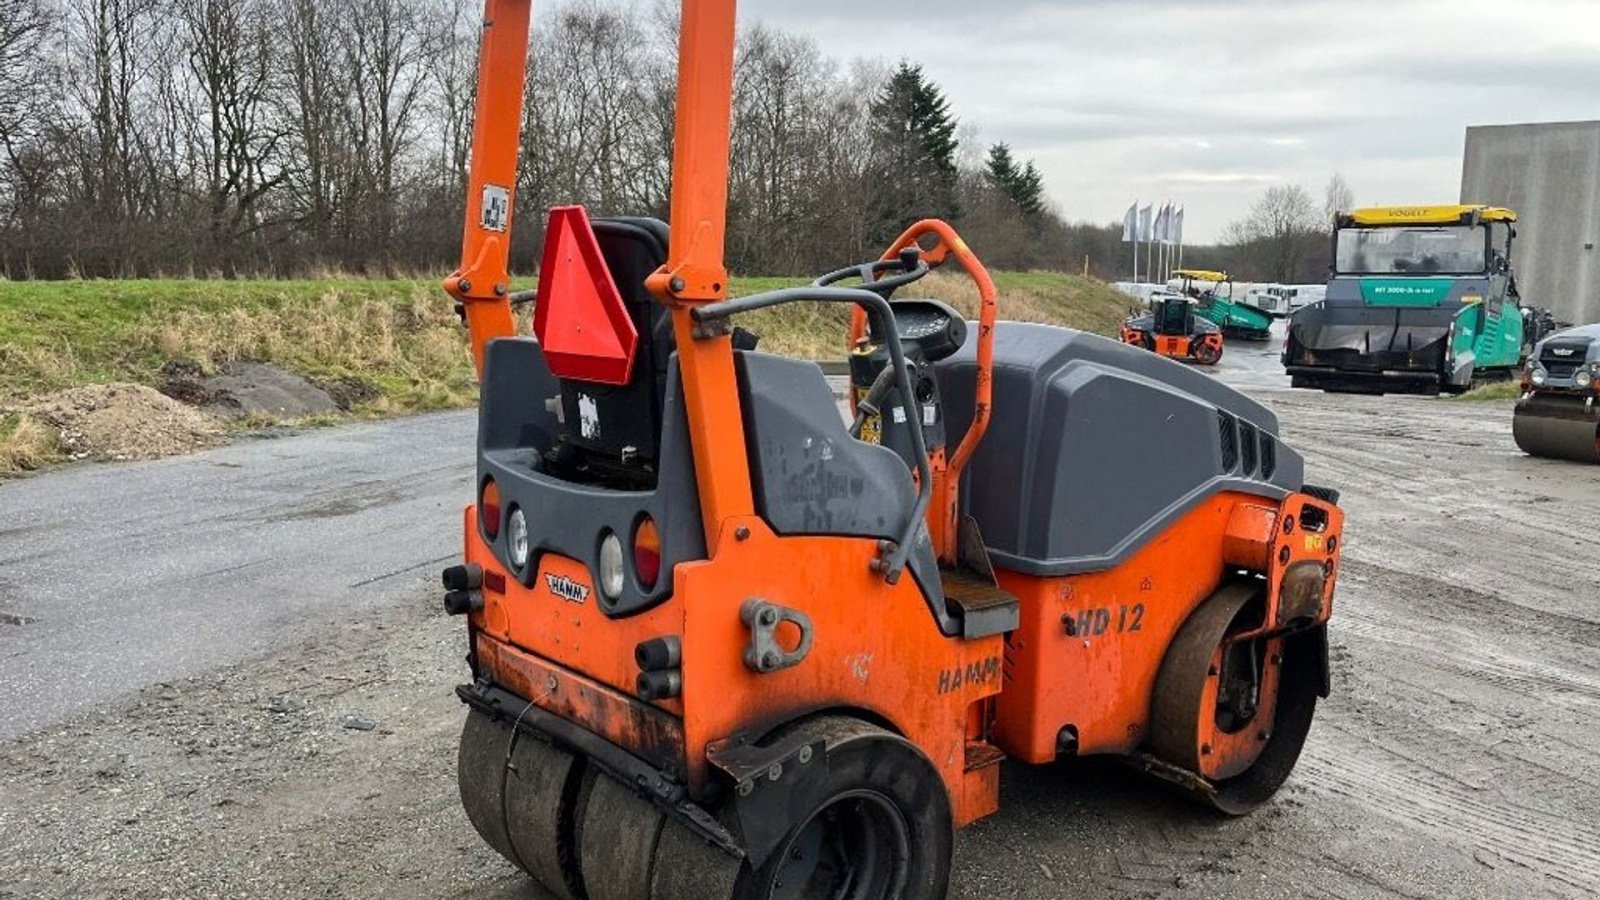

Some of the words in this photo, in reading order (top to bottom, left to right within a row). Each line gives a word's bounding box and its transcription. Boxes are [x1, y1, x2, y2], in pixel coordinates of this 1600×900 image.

[550, 577, 583, 600] HAMM
[1075, 608, 1111, 637] HD
[1117, 603, 1145, 633] 12
[937, 656, 999, 696] HAMM
